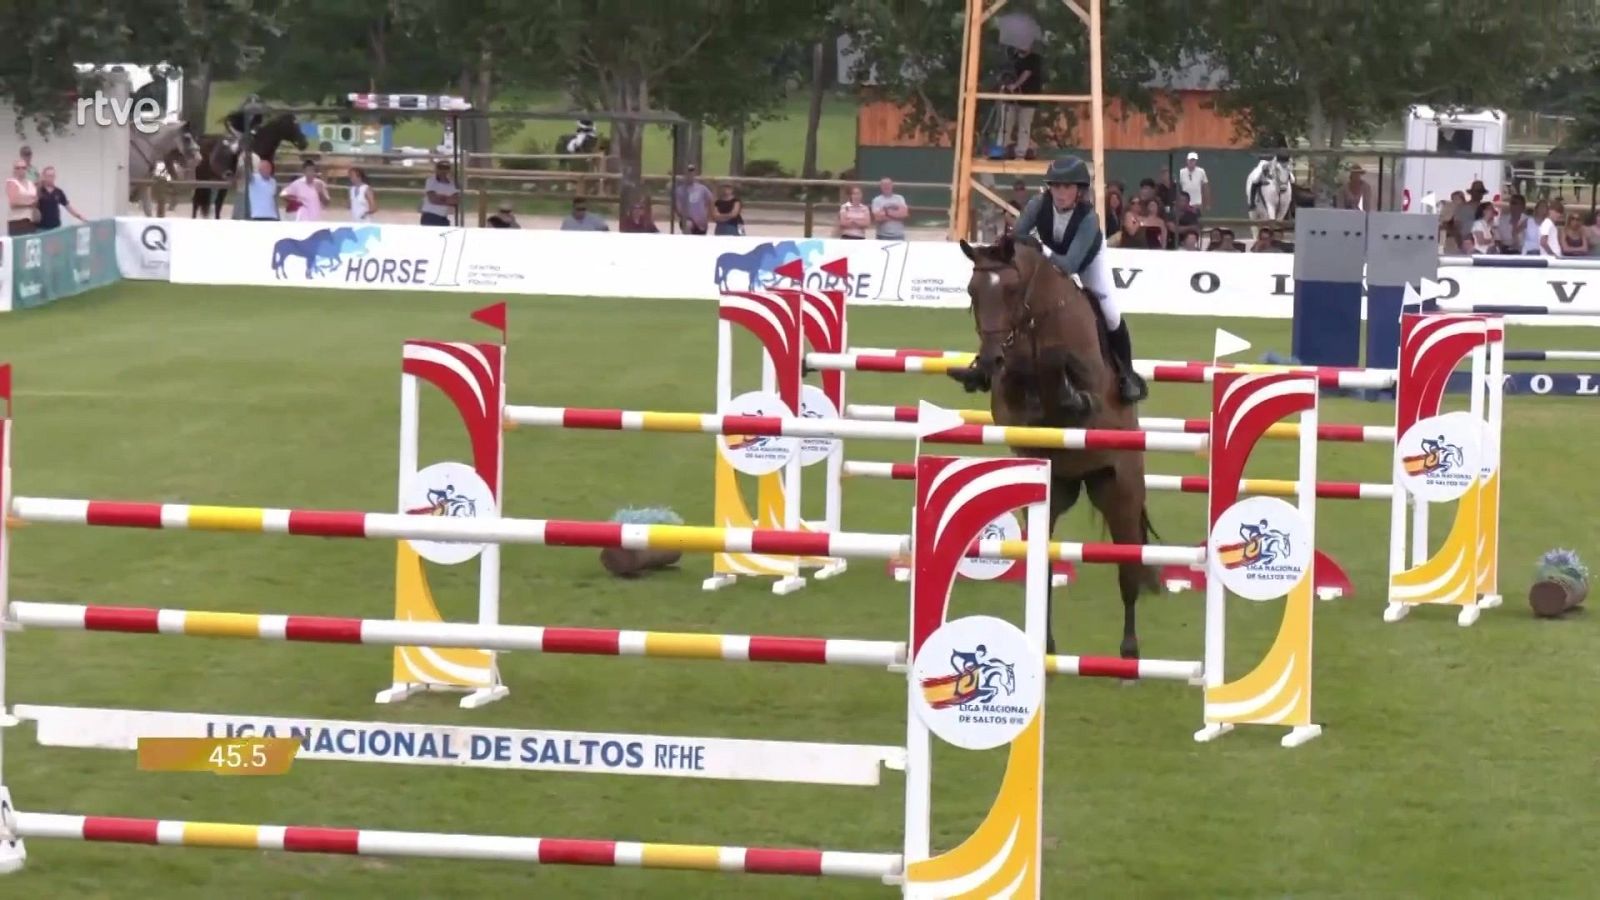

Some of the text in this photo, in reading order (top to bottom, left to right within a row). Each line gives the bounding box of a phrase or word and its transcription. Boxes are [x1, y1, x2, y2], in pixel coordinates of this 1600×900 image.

[345, 257, 429, 284] HORSE
[959, 703, 1030, 714] LIGA NACIONAL
[958, 714, 971, 723] DE
[973, 715, 1007, 724] SALTOS
[289, 726, 459, 759] NACIONAL
[470, 734, 512, 762] DE
[519, 736, 644, 768] SALTOS
[653, 743, 706, 770] RFHE
